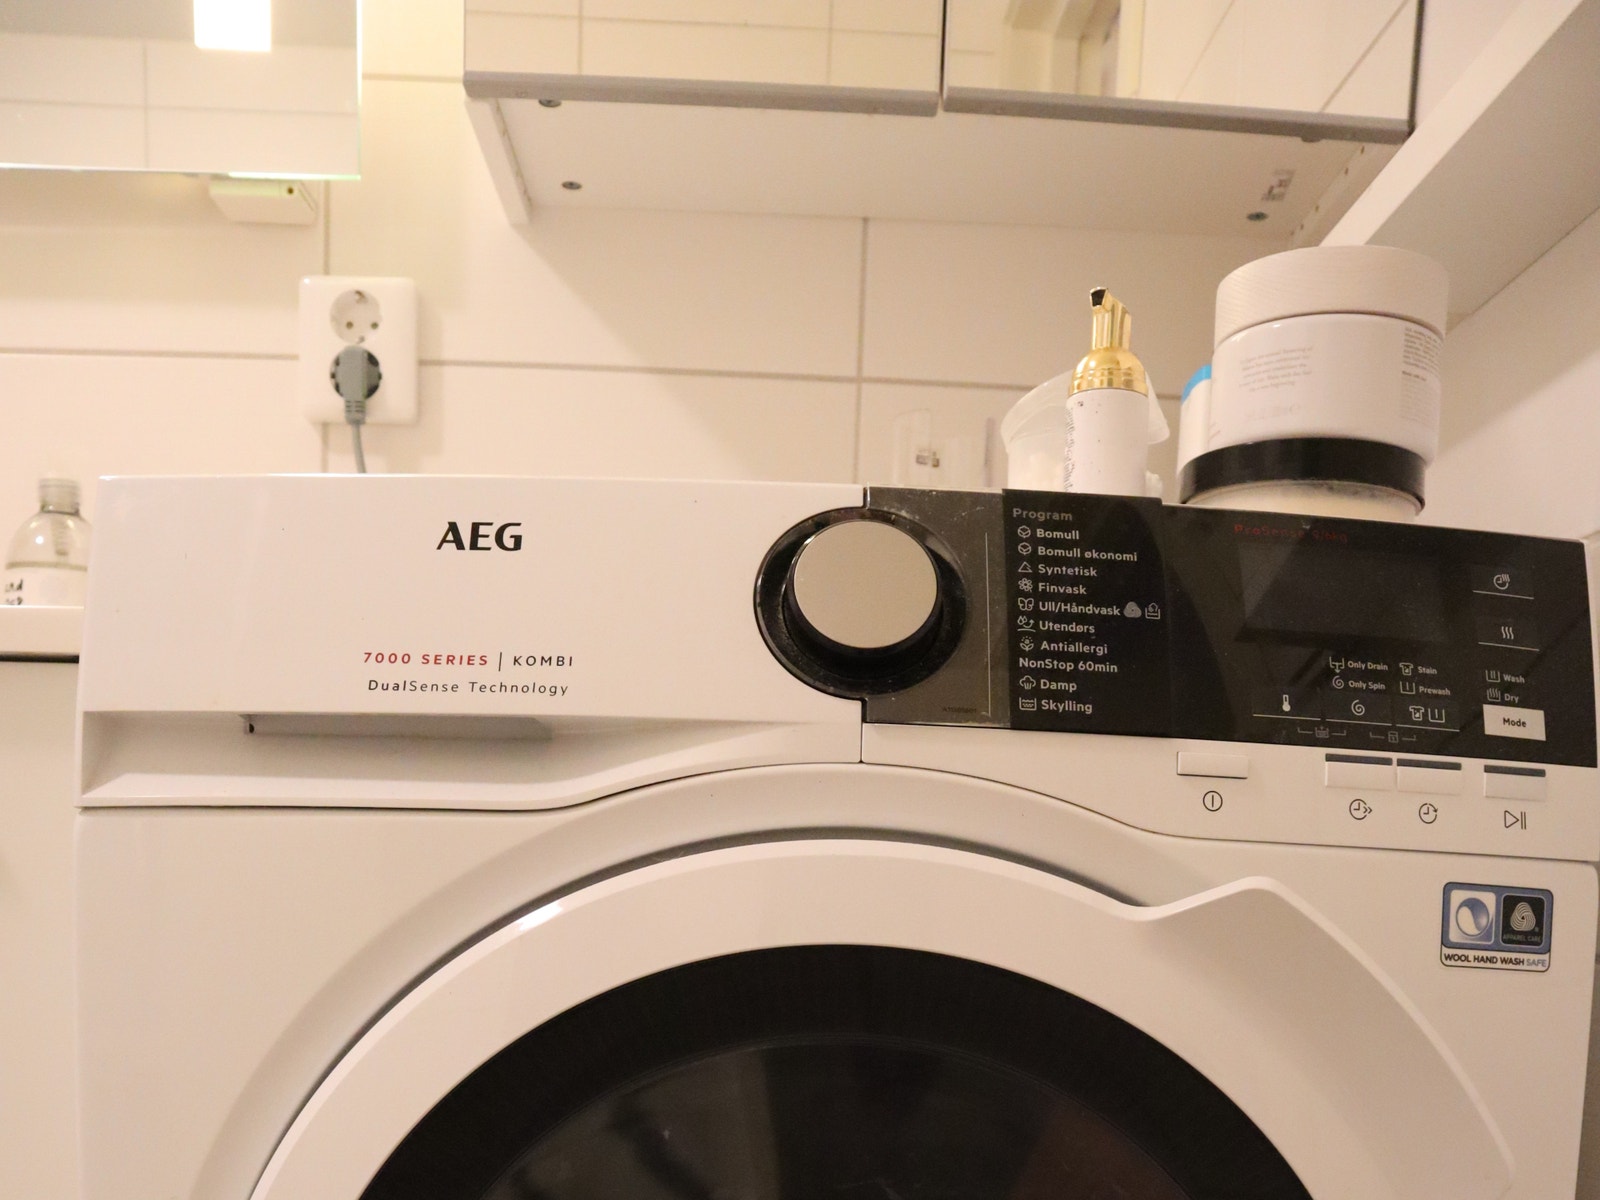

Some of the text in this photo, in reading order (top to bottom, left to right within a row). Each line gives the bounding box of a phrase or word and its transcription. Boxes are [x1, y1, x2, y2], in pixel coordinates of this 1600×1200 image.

[1012, 507, 1073, 522] Program
[436, 521, 523, 552] AEG
[1036, 528, 1080, 540] Bomull
[1037, 546, 1138, 562] Bomull økonomi
[1037, 563, 1098, 577] Syntetisk
[1038, 582, 1087, 595] Finvask
[1038, 600, 1121, 616] Ull/Håndvask
[1039, 620, 1096, 634] Utendørs
[1040, 640, 1108, 656] Antiallergi
[363, 651, 489, 666] 7000 SERIES
[512, 655, 574, 668] KOMBI
[1019, 656, 1118, 673] NonStop 60min
[1347, 660, 1389, 671] Only Drain
[1417, 665, 1438, 675] Stain
[1040, 678, 1078, 693] Damp
[1348, 680, 1386, 691] Only Spin
[1502, 673, 1526, 684] Wash
[367, 679, 569, 697] DualSense Technology
[1418, 685, 1451, 696] Prewash
[1503, 693, 1520, 704] Dry
[1040, 699, 1093, 715] Skylling
[1502, 716, 1527, 728] Mode
[1443, 952, 1548, 968] WOOL HAND WASH SAFE
